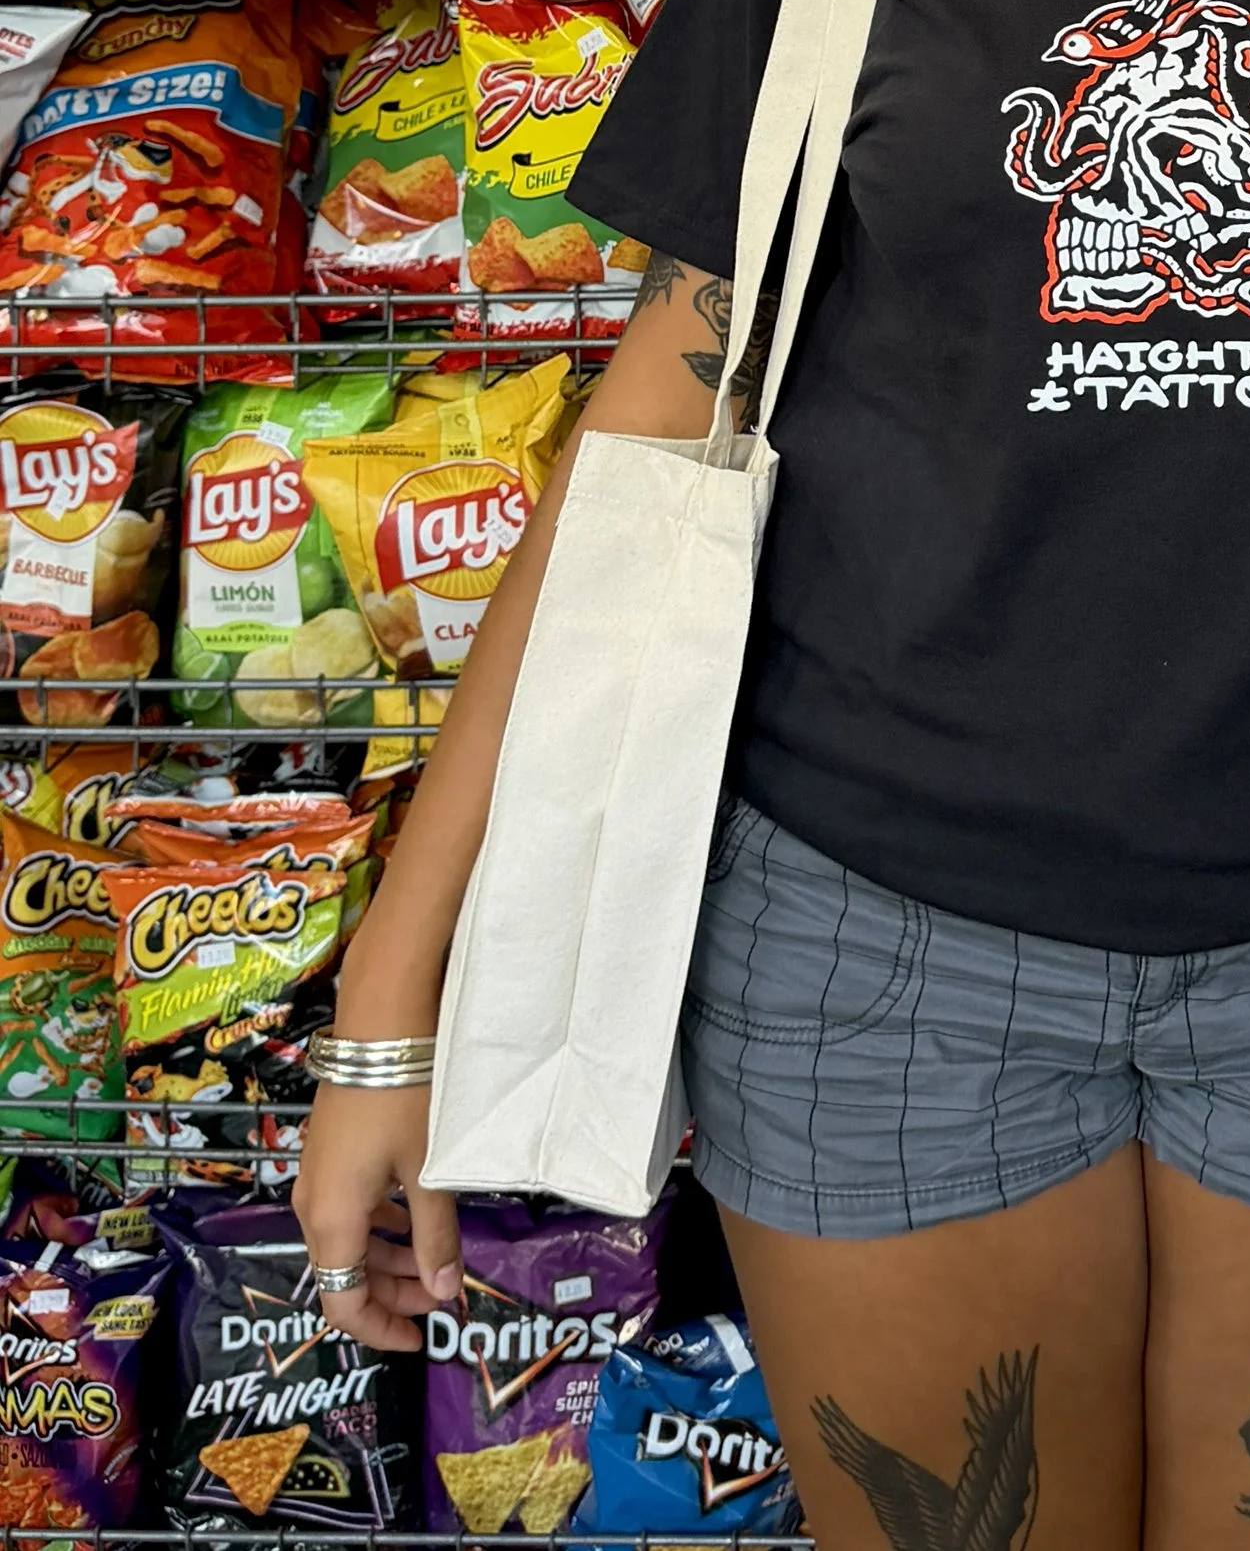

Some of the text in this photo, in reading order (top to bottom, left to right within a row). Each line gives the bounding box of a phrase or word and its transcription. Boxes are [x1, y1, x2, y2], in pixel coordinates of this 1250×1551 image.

[79, 14, 197, 62] Crunchy
[127, 70, 228, 106] Size!
[393, 107, 435, 133] CHILE
[526, 163, 573, 190] CHILE
[0, 430, 118, 511] Lay's
[189, 459, 301, 543] Lay's
[398, 482, 526, 580] Lay's
[12, 558, 90, 587] BARBECUE
[210, 582, 275, 601] LIMÓN
[131, 872, 302, 970] Cheetos
[0, 1332, 79, 1365] oritos
[427, 1310, 619, 1365] Doritos
[186, 1370, 267, 1420] LATE
[253, 1363, 383, 1427] NIGHT
[323, 1414, 378, 1439] TACO
